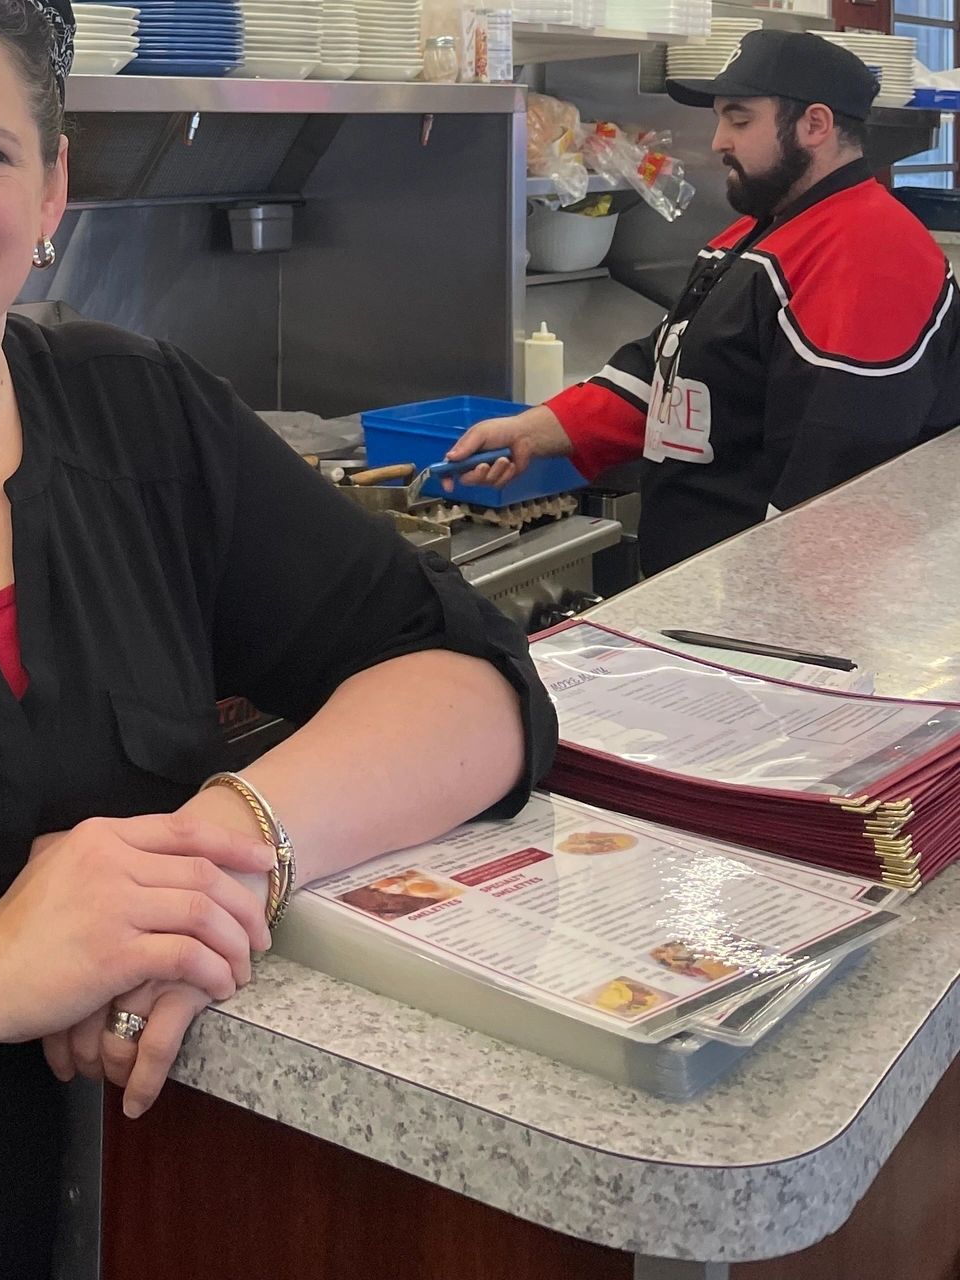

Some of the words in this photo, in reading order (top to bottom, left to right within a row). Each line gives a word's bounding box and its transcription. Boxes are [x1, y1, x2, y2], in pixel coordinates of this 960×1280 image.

[480, 873, 526, 893] SPECIALTY
[492, 876, 543, 898] OMELETTES
[408, 898, 463, 921] OMELETTES
